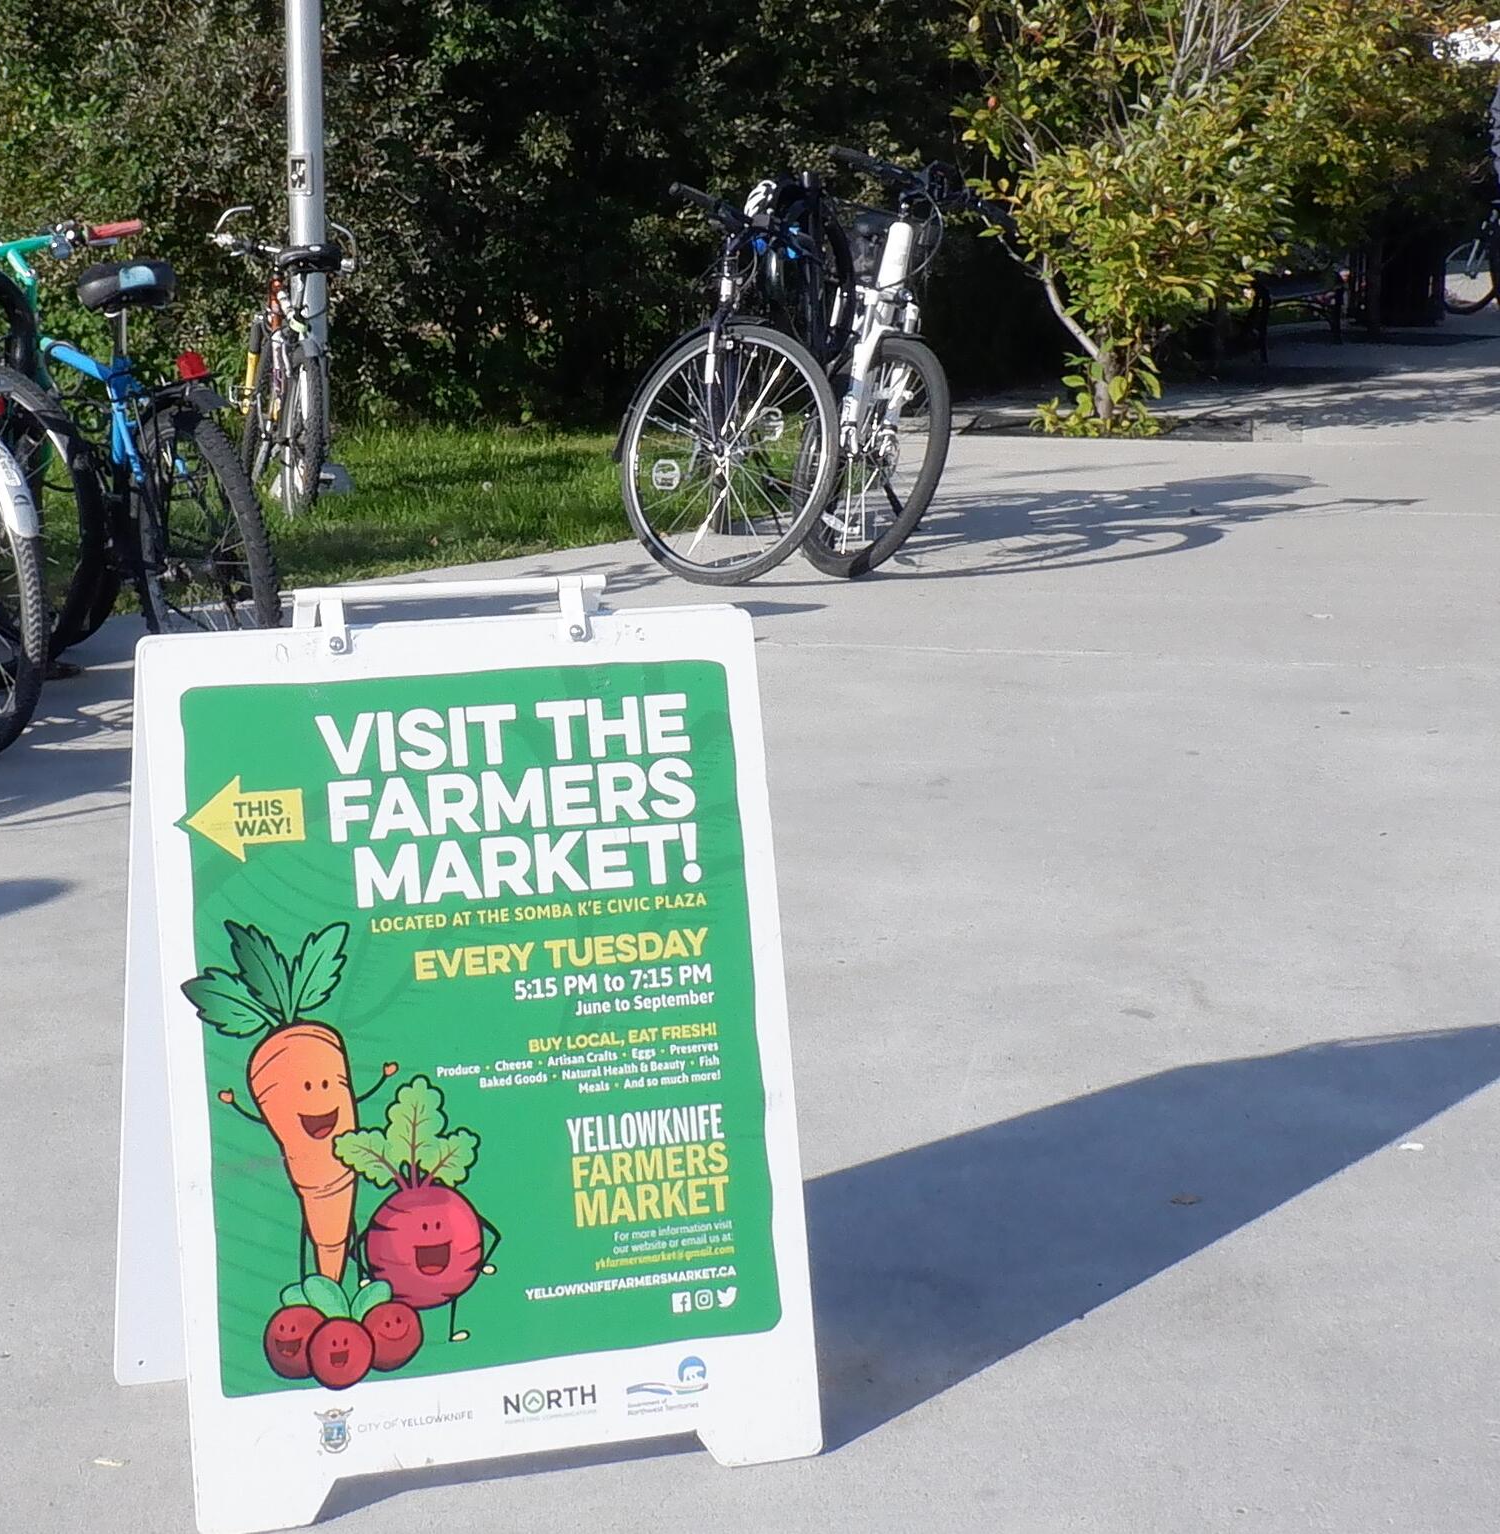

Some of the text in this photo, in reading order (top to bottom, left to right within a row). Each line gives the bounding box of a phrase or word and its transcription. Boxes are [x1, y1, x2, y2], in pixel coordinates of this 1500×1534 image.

[315, 693, 691, 775] VISIT THE
[233, 798, 283, 819] THIS
[327, 757, 697, 843] FARMERS
[234, 816, 292, 838] WAY!
[354, 823, 702, 909] MARKET!
[371, 914, 446, 933] LOCATED
[453, 911, 472, 926] AT
[477, 908, 510, 924] THE
[514, 903, 573, 922] SOMBA
[607, 896, 650, 914] CIVIC
[655, 893, 707, 909] PLAZA
[414, 927, 708, 981] EVERY TUESDAY
[514, 963, 712, 1001] 5:15 PM to 7:15 PM
[575, 989, 715, 1016] June to September
[529, 1022, 717, 1053] BUY LOCAL, EAT FRESH!
[436, 1041, 719, 1078] Produce Cheese Artisan Crafts Eggs Preserves
[479, 1054, 720, 1089] Baked Goods Natural Health & Beauty Fish
[578, 1069, 721, 1094] Meals And so much more!
[566, 1103, 725, 1153] YELLOWKNIFE
[572, 1141, 729, 1189] FARMERS
[574, 1175, 729, 1228] MARKET
[612, 1245, 629, 1254] our
[631, 1239, 667, 1252] website
[669, 1239, 679, 1247] or
[681, 1234, 707, 1246] email
[709, 1234, 720, 1243] us
[614, 1220, 732, 1242] For more information visit
[525, 1266, 736, 1301] YELLOWKNIFEFARMERSMARKET.CA
[503, 1384, 597, 1415] NORTH
[358, 1410, 473, 1433] CITY OF YELLOWKNIFE
